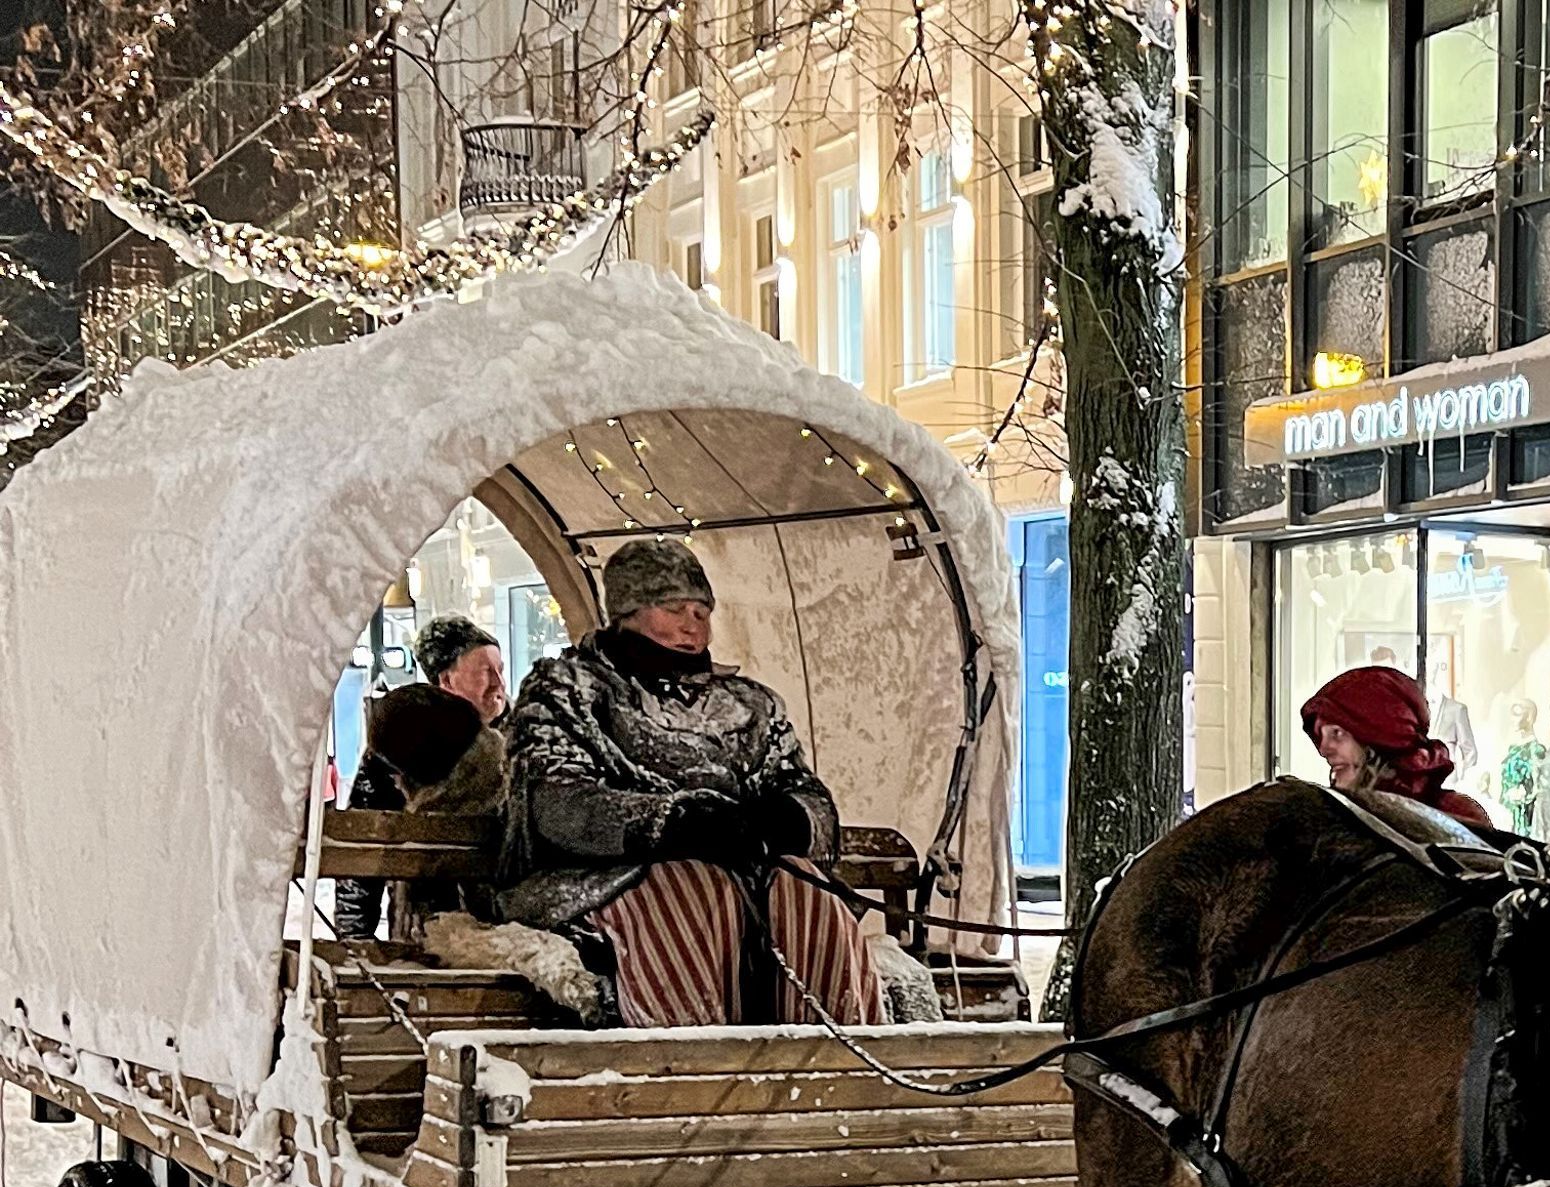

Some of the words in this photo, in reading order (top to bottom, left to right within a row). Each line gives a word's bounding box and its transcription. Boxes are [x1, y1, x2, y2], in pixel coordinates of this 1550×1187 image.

[1284, 408, 1346, 454] man
[1350, 386, 1408, 443] and
[1413, 373, 1530, 435] woman
